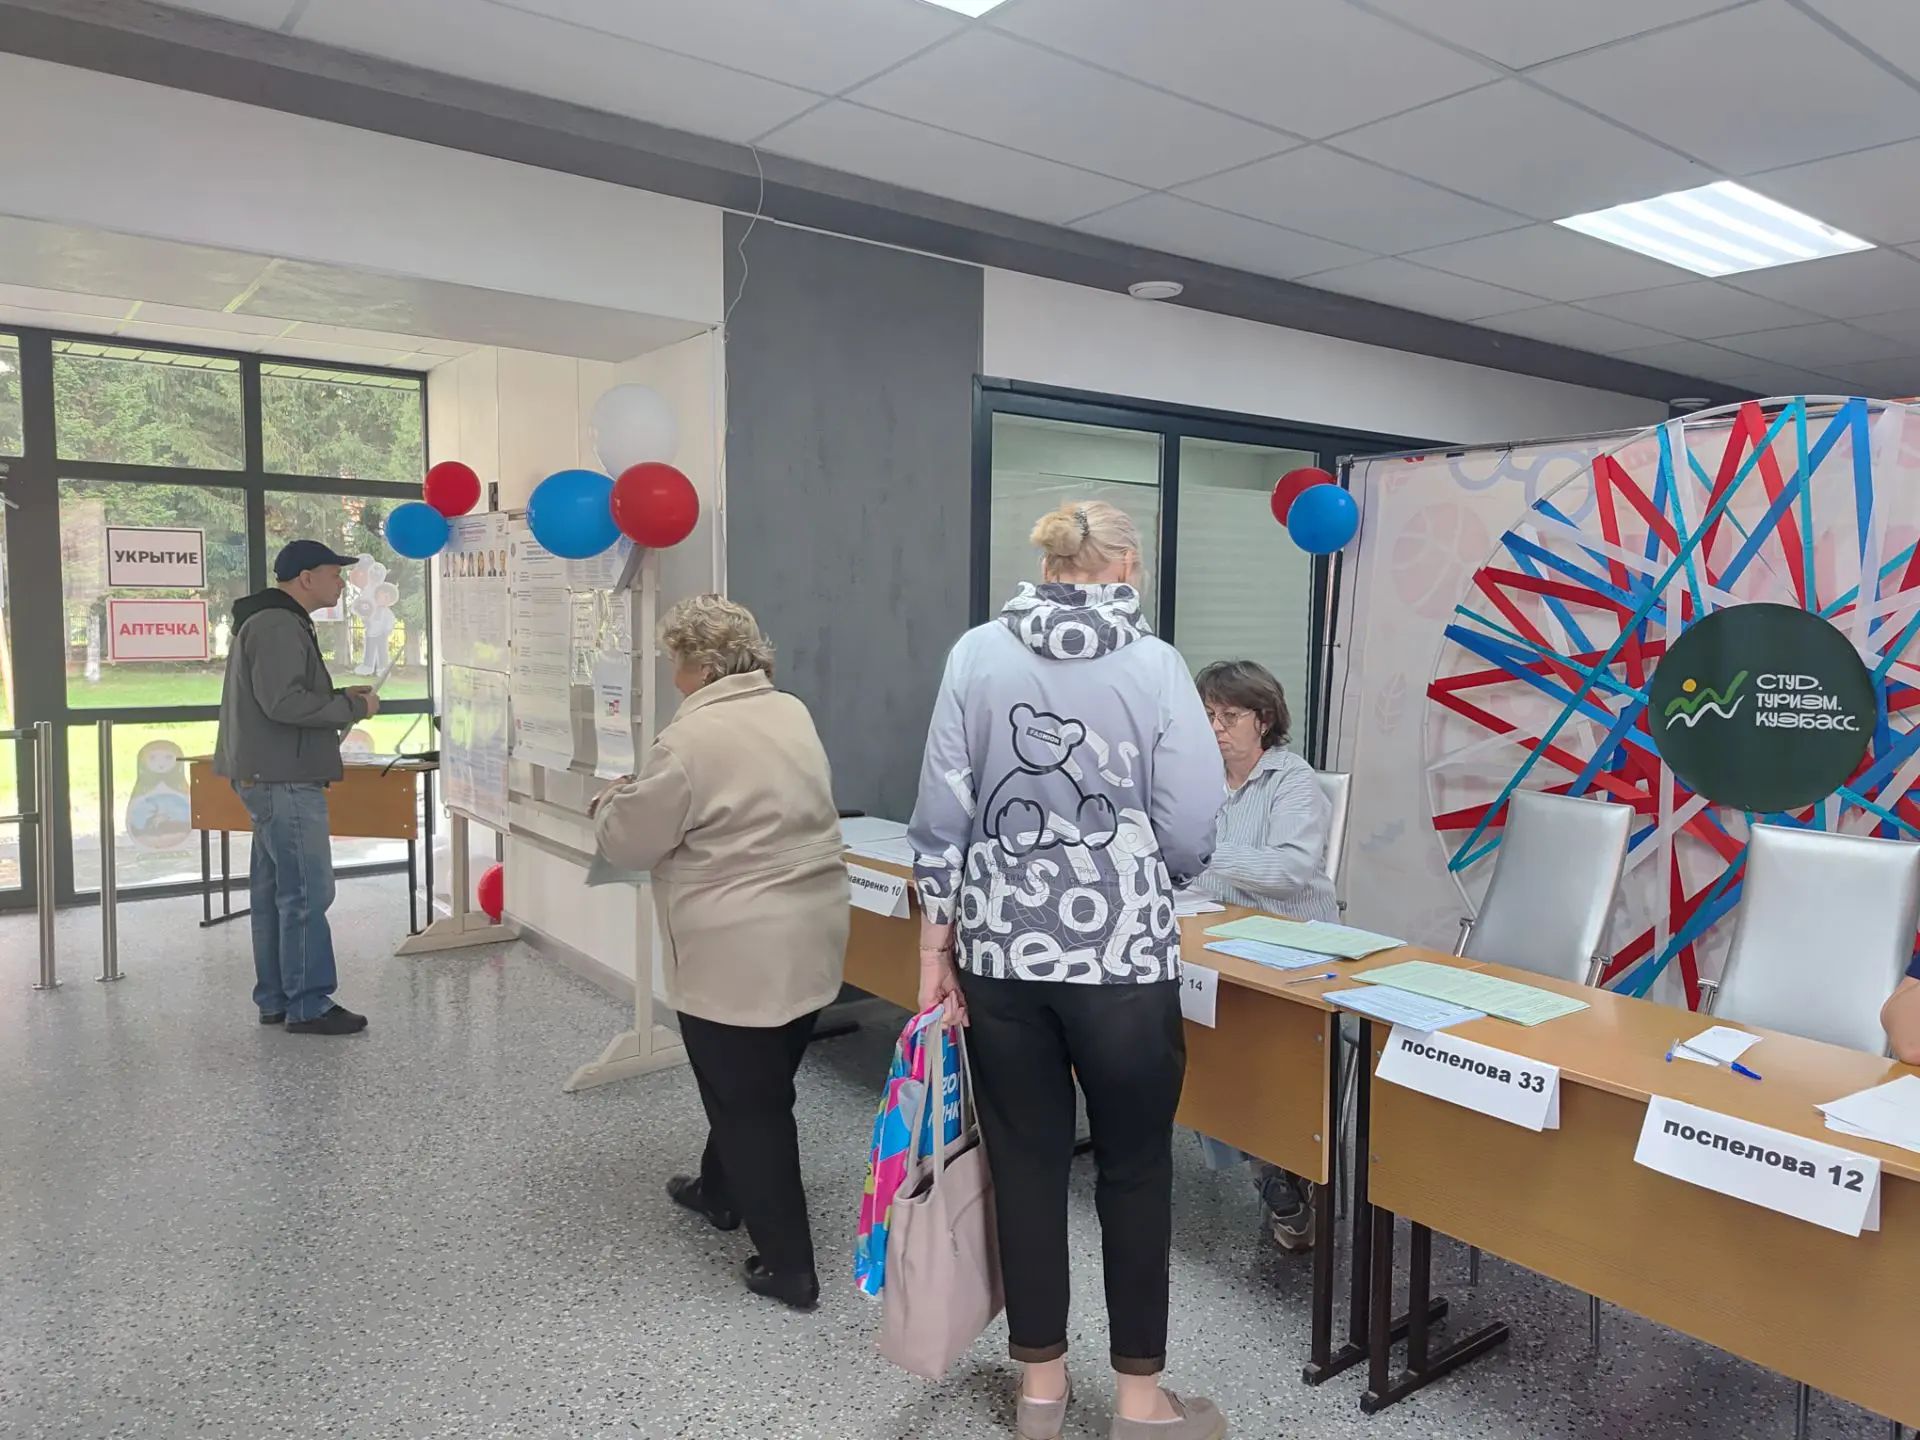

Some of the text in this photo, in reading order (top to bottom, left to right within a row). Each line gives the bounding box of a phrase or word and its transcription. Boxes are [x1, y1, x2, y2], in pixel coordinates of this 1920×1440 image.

[114, 550, 198, 565] УКРЫТИЕ
[119, 623, 200, 636] АПТЕЧКА
[891, 885, 902, 897] 10
[1189, 978, 1203, 991] 14
[1400, 1039, 1546, 1094] поспелова 33
[1663, 1119, 1865, 1193] поспелова 12
